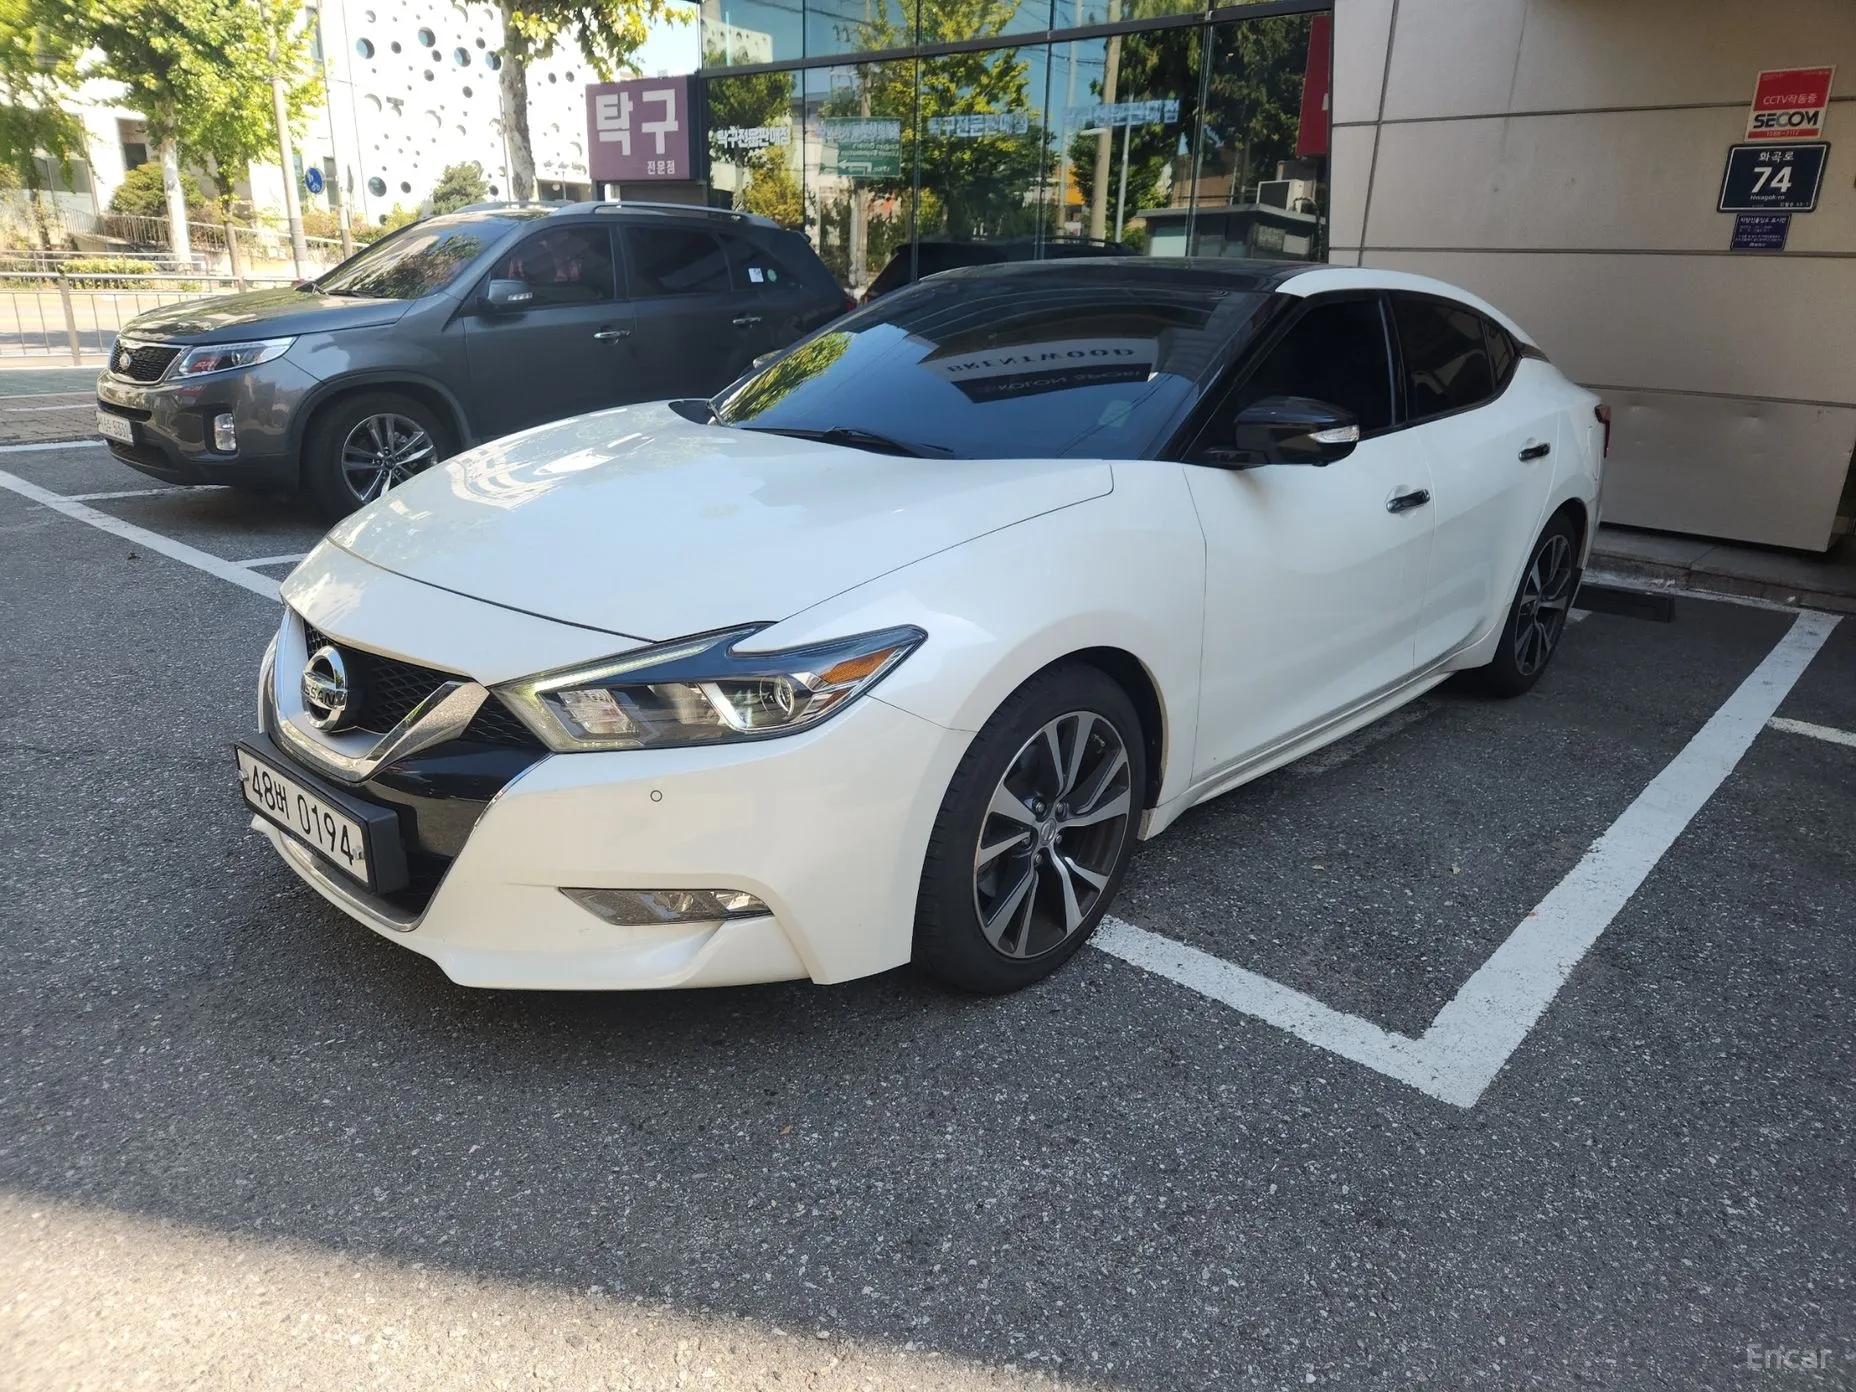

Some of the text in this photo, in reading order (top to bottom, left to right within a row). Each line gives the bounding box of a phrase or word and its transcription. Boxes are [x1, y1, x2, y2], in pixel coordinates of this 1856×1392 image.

[1762, 94, 1818, 106] CCTV작동중
[595, 88, 679, 156] 탁구
[1753, 110, 1820, 129] SECOM
[1758, 151, 1794, 163] 화곡로
[647, 159, 675, 175] 전문점
[1751, 166, 1792, 193] 74
[252, 765, 354, 866] 48버 0194
